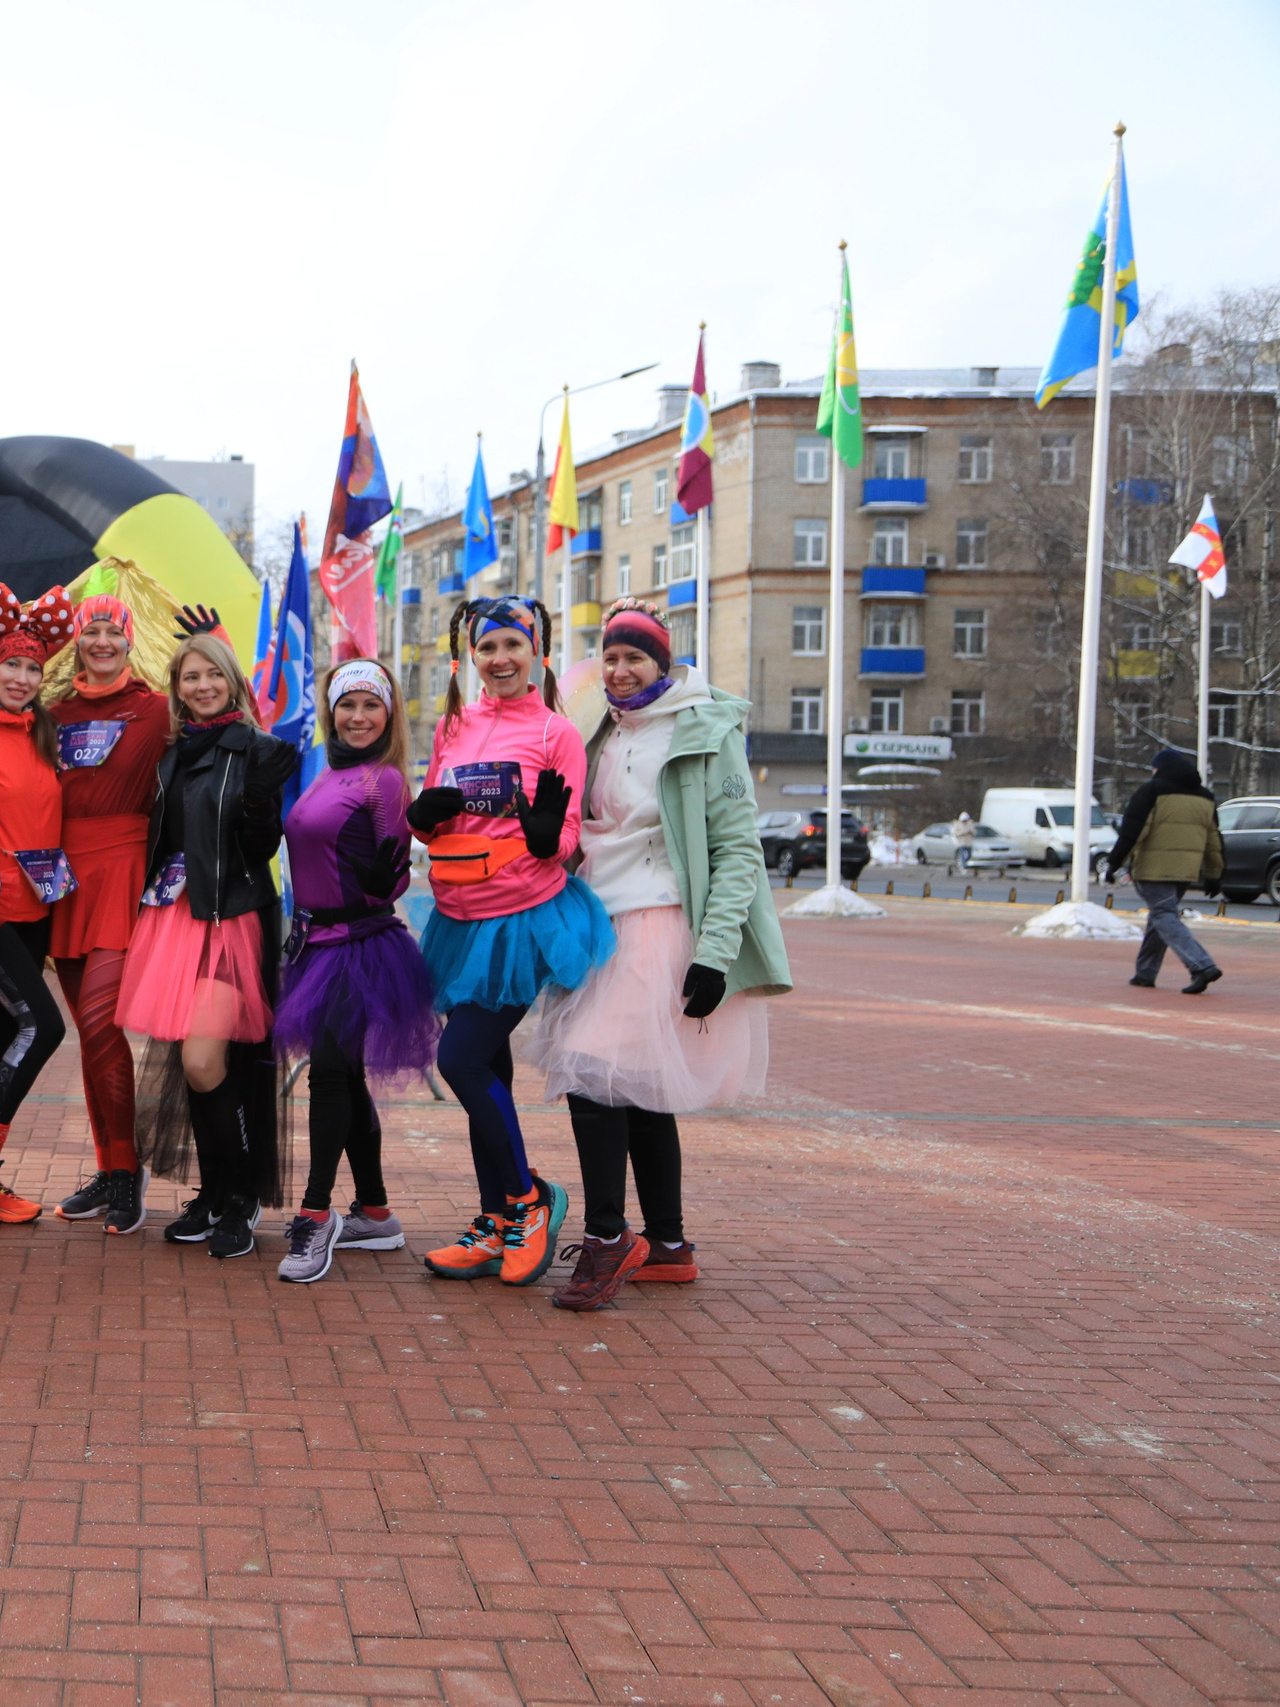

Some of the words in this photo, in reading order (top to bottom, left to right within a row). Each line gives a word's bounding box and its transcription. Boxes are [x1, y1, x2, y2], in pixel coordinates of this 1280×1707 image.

[74, 748, 100, 761] 027
[481, 787, 501, 796] 2023
[465, 800, 492, 812] 091
[43, 870, 55, 878] 2023
